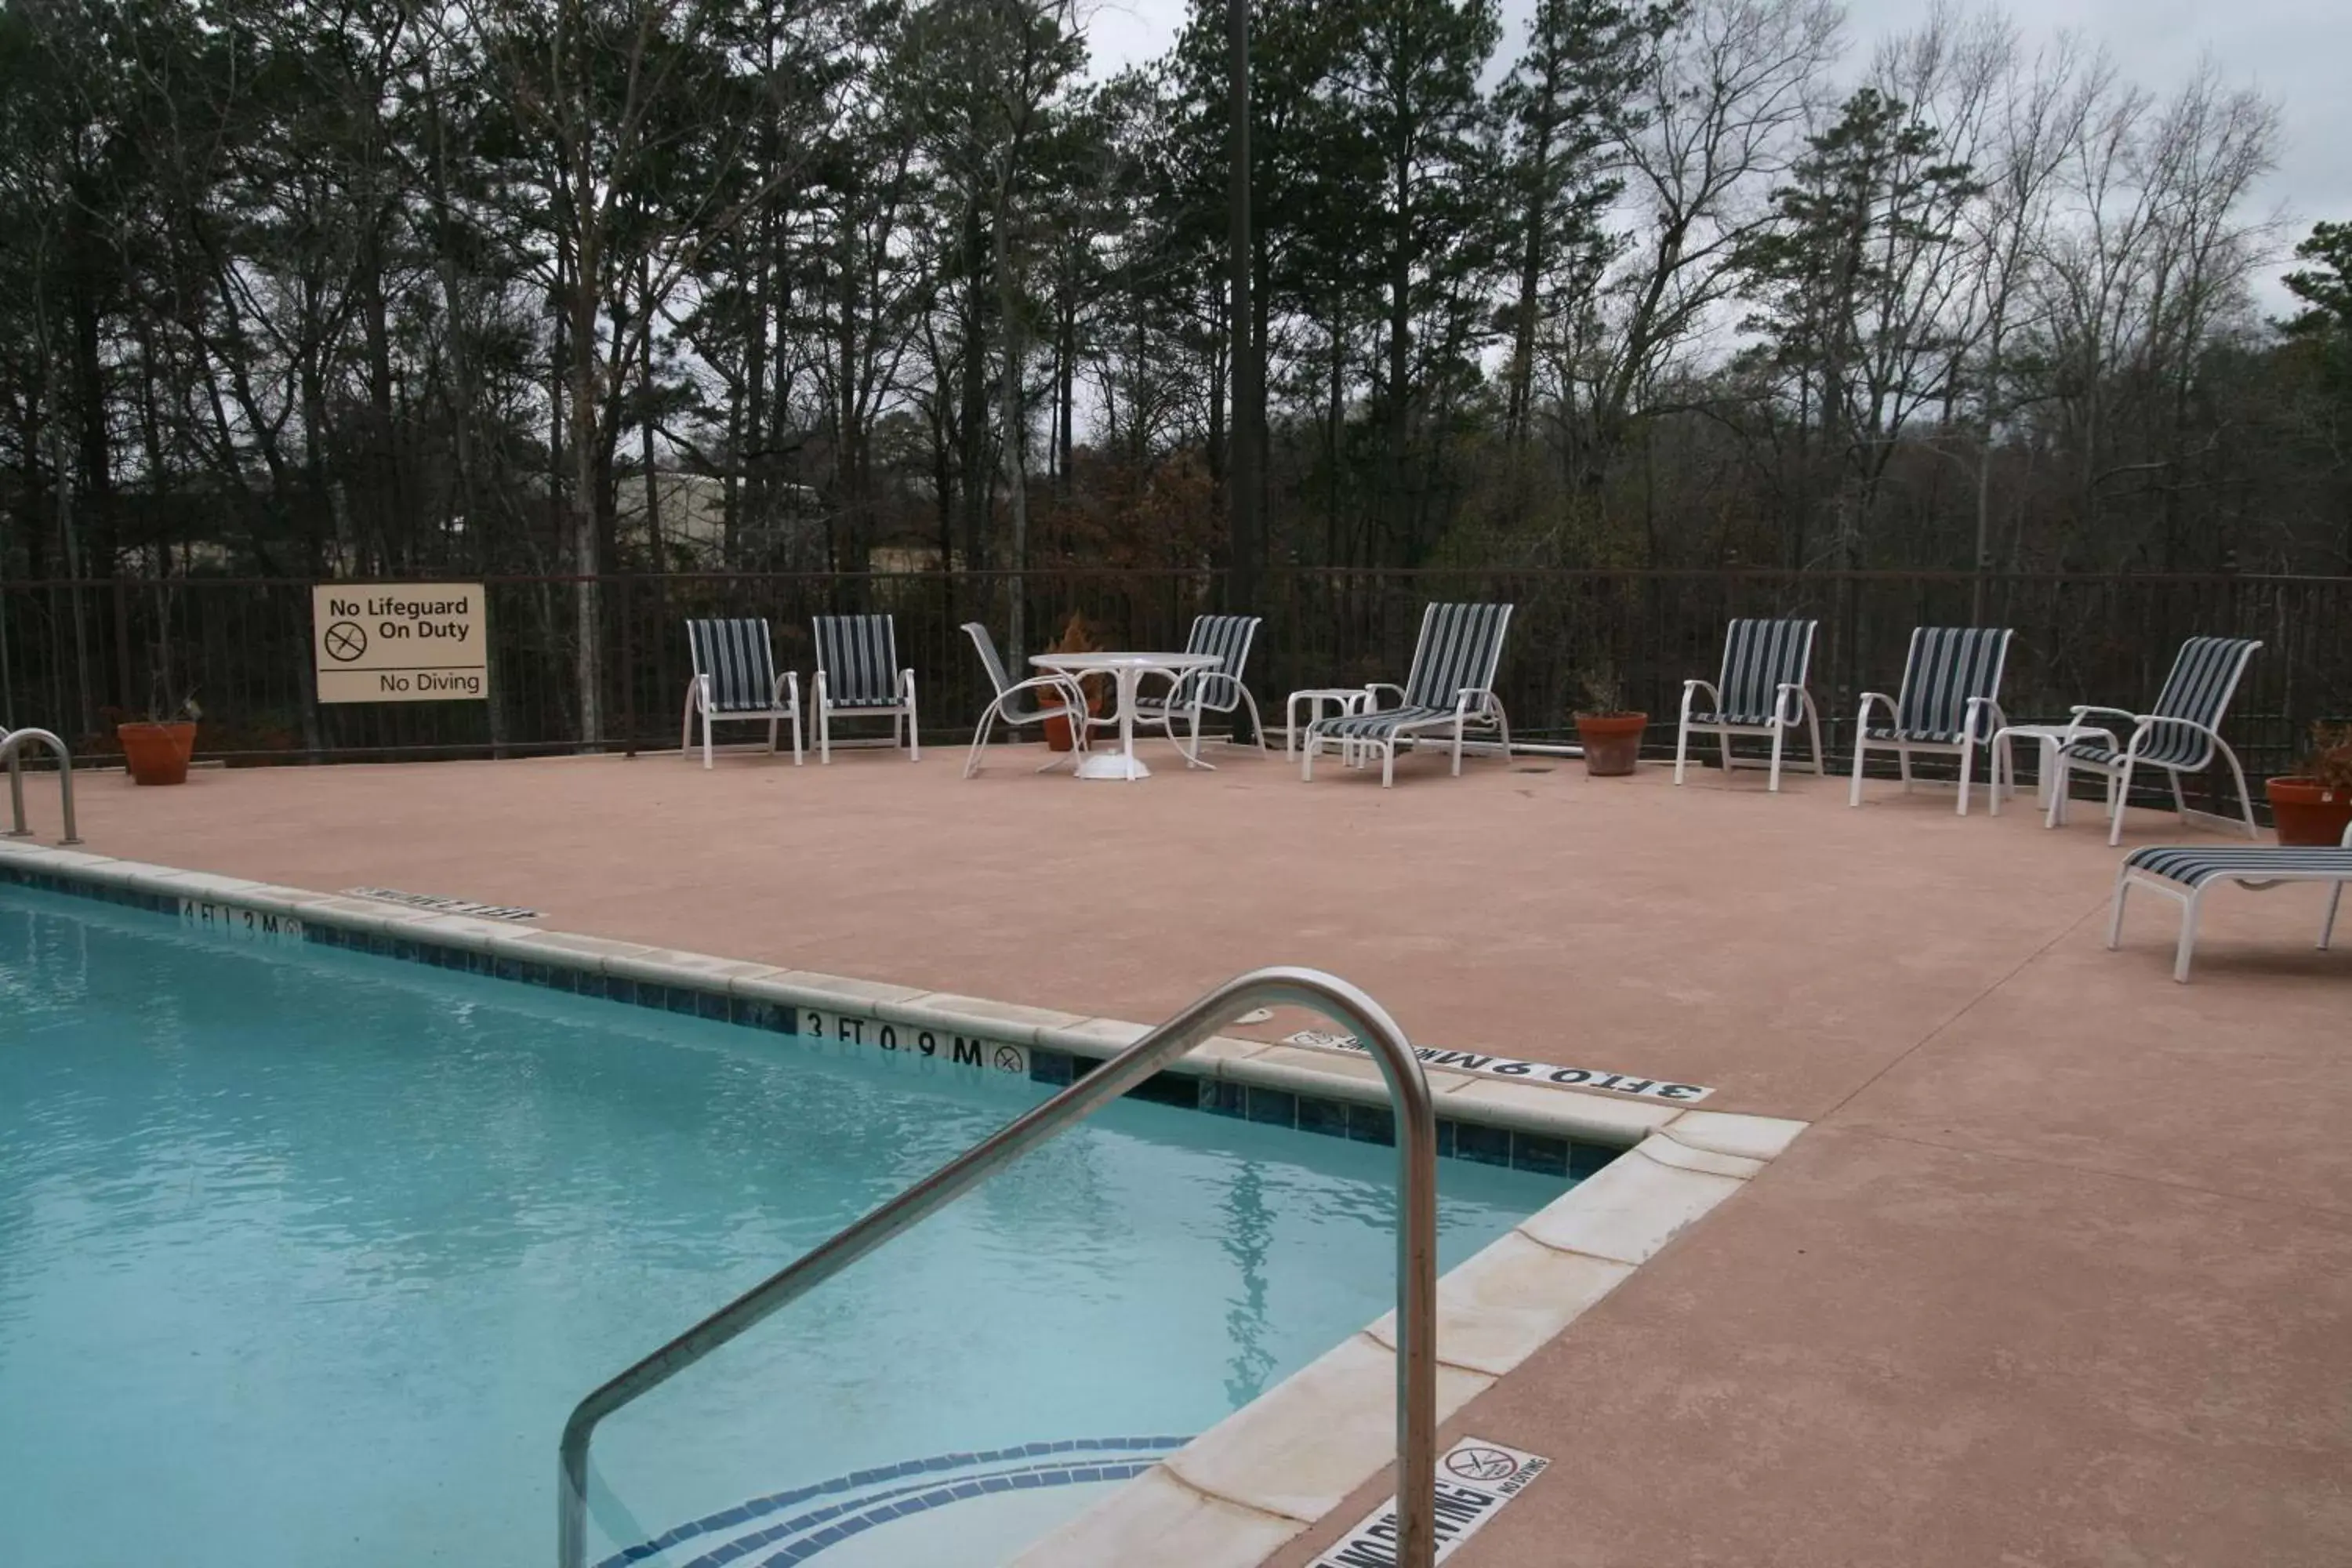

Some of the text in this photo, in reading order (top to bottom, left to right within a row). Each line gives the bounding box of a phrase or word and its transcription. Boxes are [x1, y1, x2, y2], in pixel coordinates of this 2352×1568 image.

[330, 596, 468, 619] No Lifeguard
[379, 621, 470, 642] On Duty
[380, 672, 480, 694] No Diving
[262, 915, 278, 934] M
[807, 1012, 822, 1038] 3
[838, 1017, 865, 1046] FT
[953, 1036, 982, 1068] M
[1434, 1051, 1494, 1069] M
[1657, 1084, 1702, 1099] 3
[1496, 1481, 1520, 1494] NO
